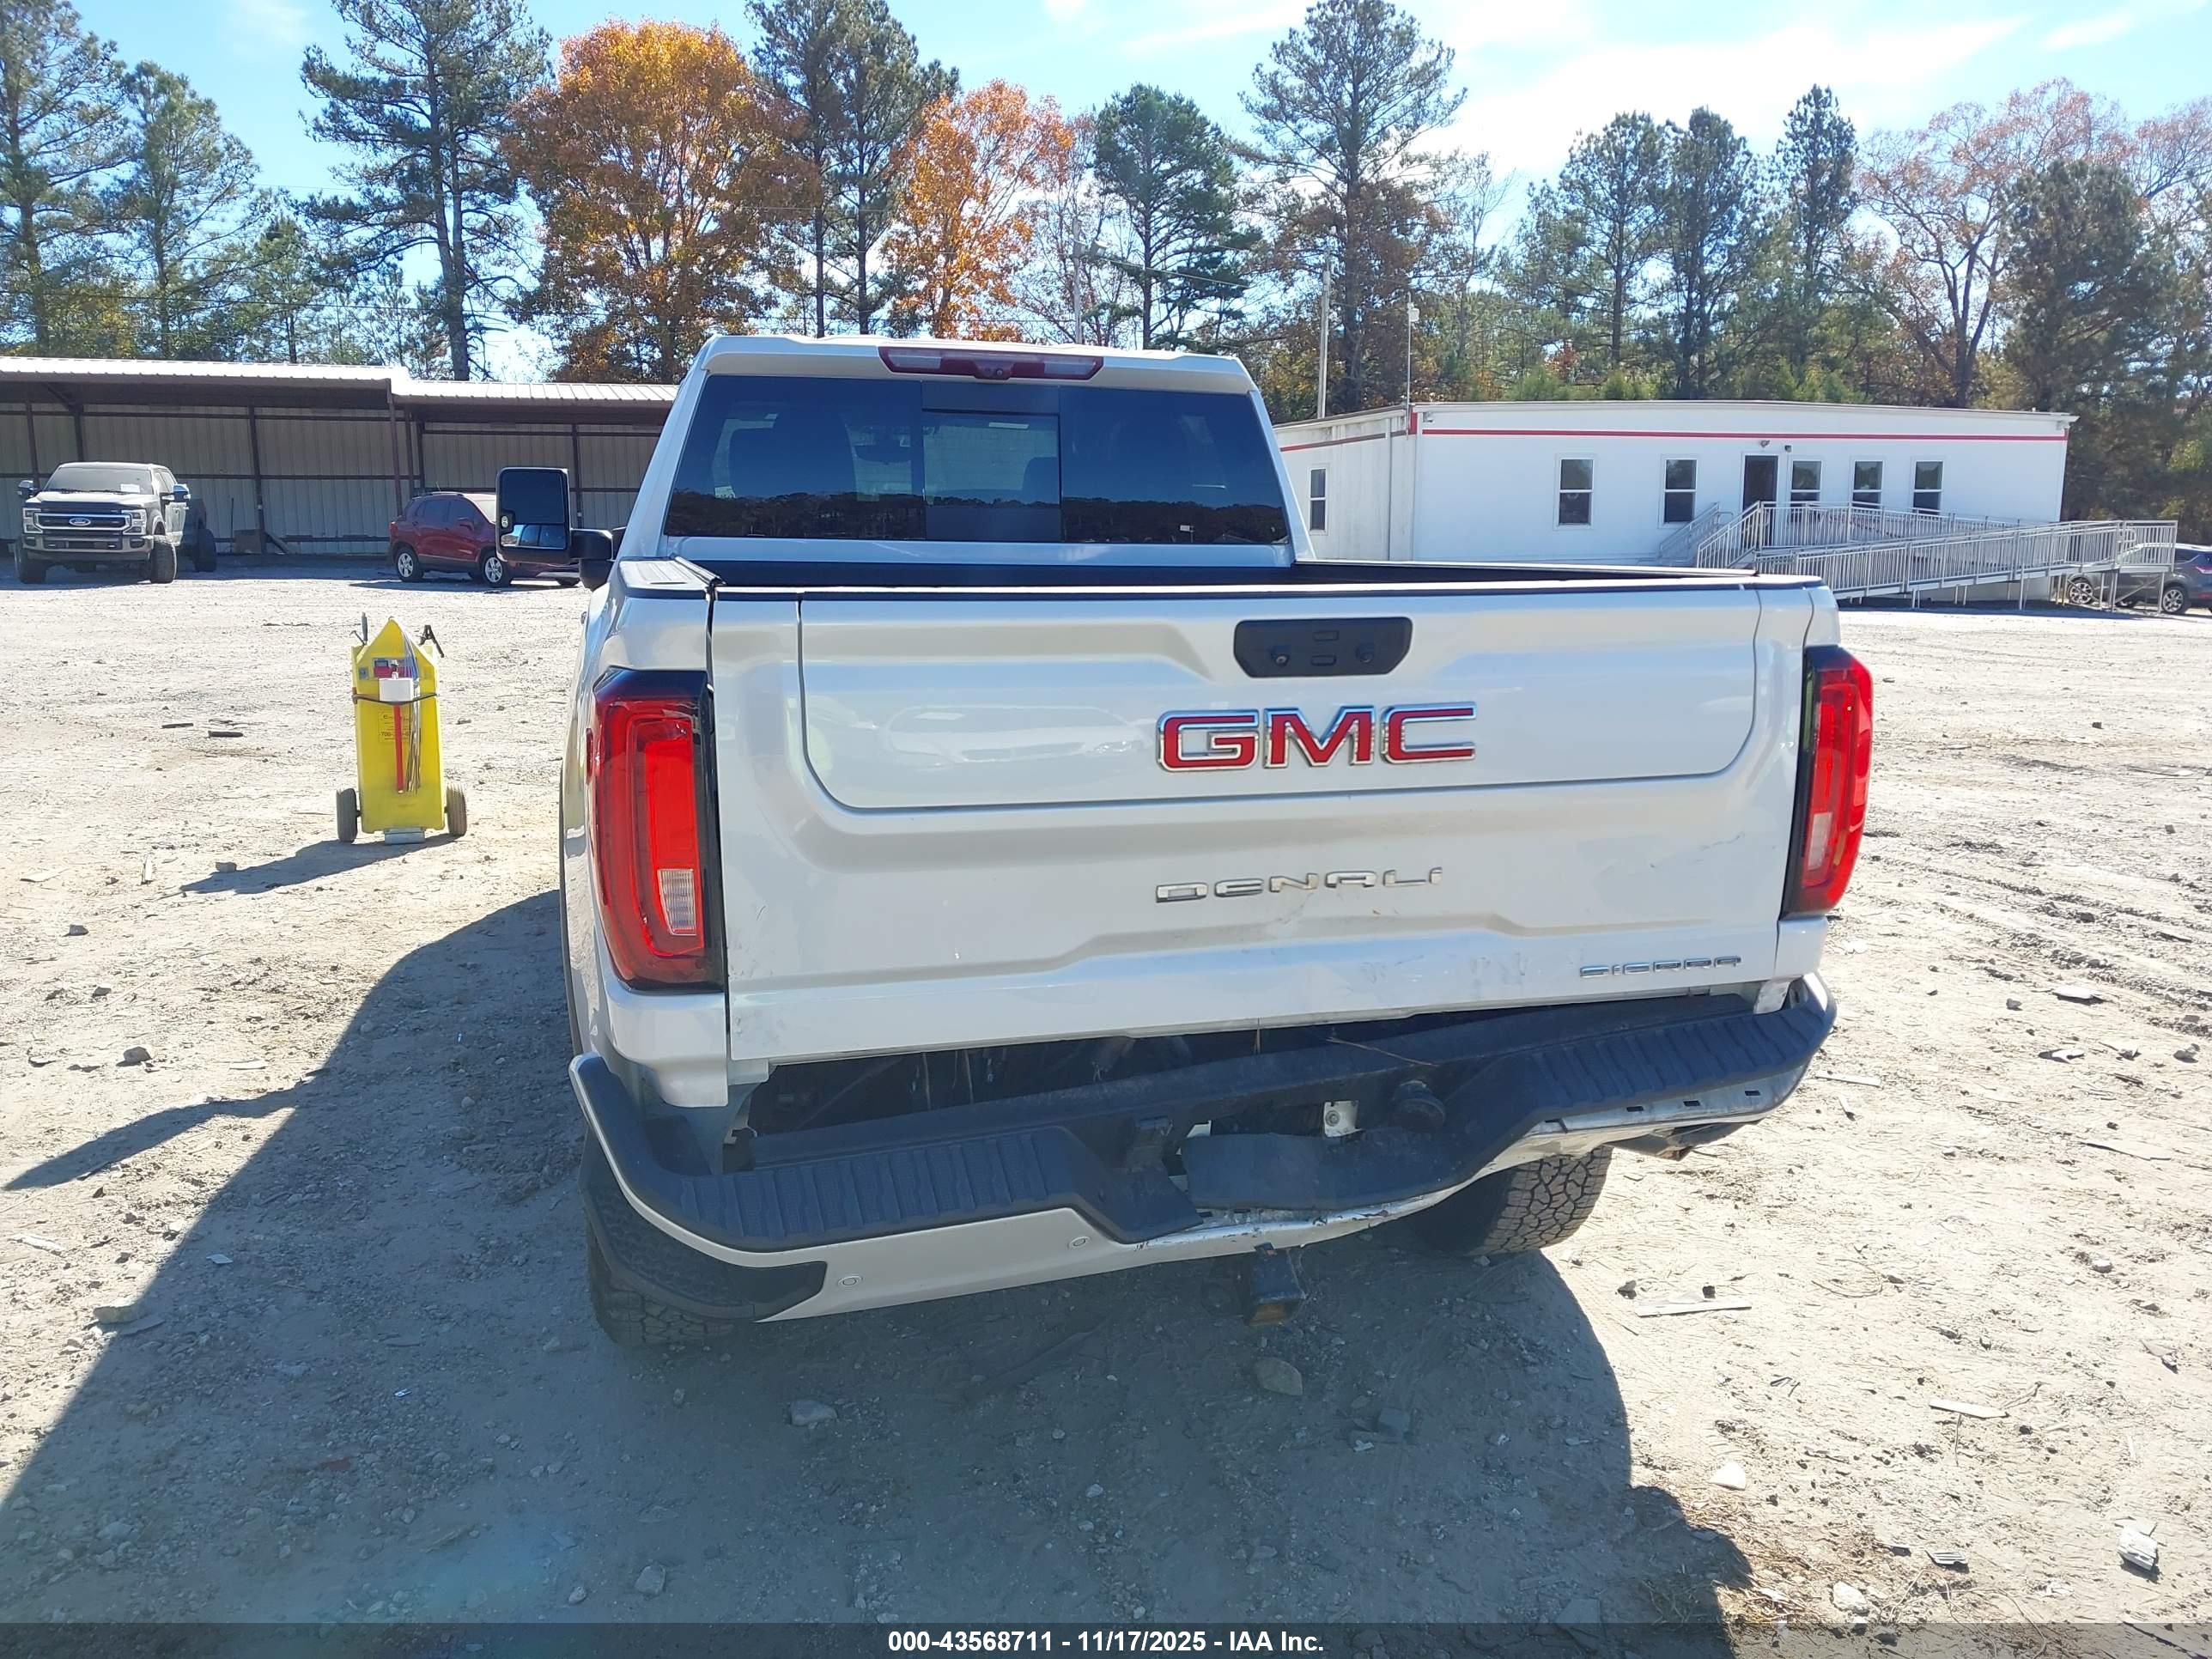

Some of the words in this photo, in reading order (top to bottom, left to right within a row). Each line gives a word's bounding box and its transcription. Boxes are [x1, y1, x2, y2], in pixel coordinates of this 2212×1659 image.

[1158, 702, 1477, 772] GMC
[1156, 867, 1443, 902] DENALI
[1580, 956, 1741, 978] SIERRA
